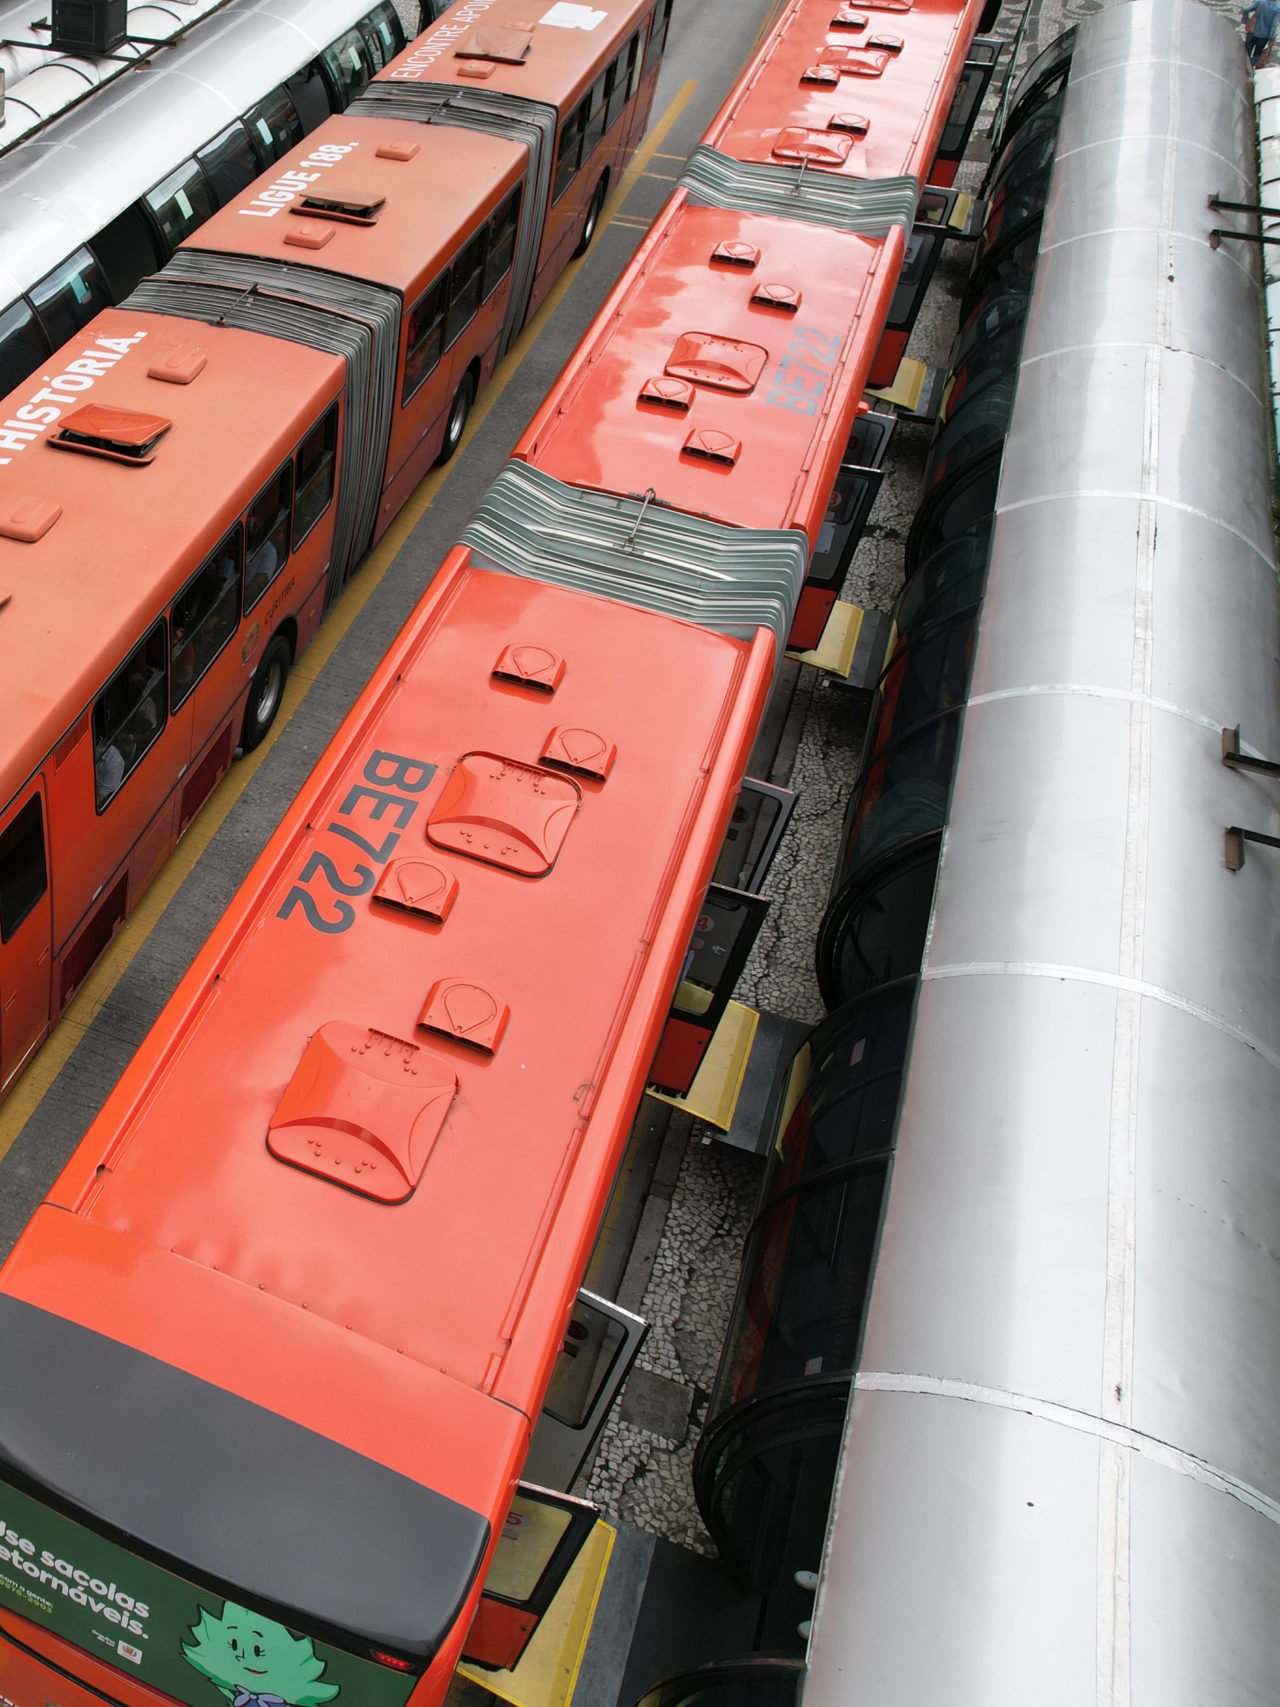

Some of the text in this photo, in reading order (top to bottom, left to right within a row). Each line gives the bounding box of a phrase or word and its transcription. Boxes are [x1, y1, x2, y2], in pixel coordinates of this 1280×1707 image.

[390, 0, 497, 78] ENCONTRE APOI
[238, 142, 360, 217] LIGUE 188.
[765, 326, 842, 416] BE722
[276, 749, 439, 935] BE722
[0, 1574, 19, 1588] com
[19, 1585, 26, 1593] a
[40, 1550, 150, 1618] sacolas
